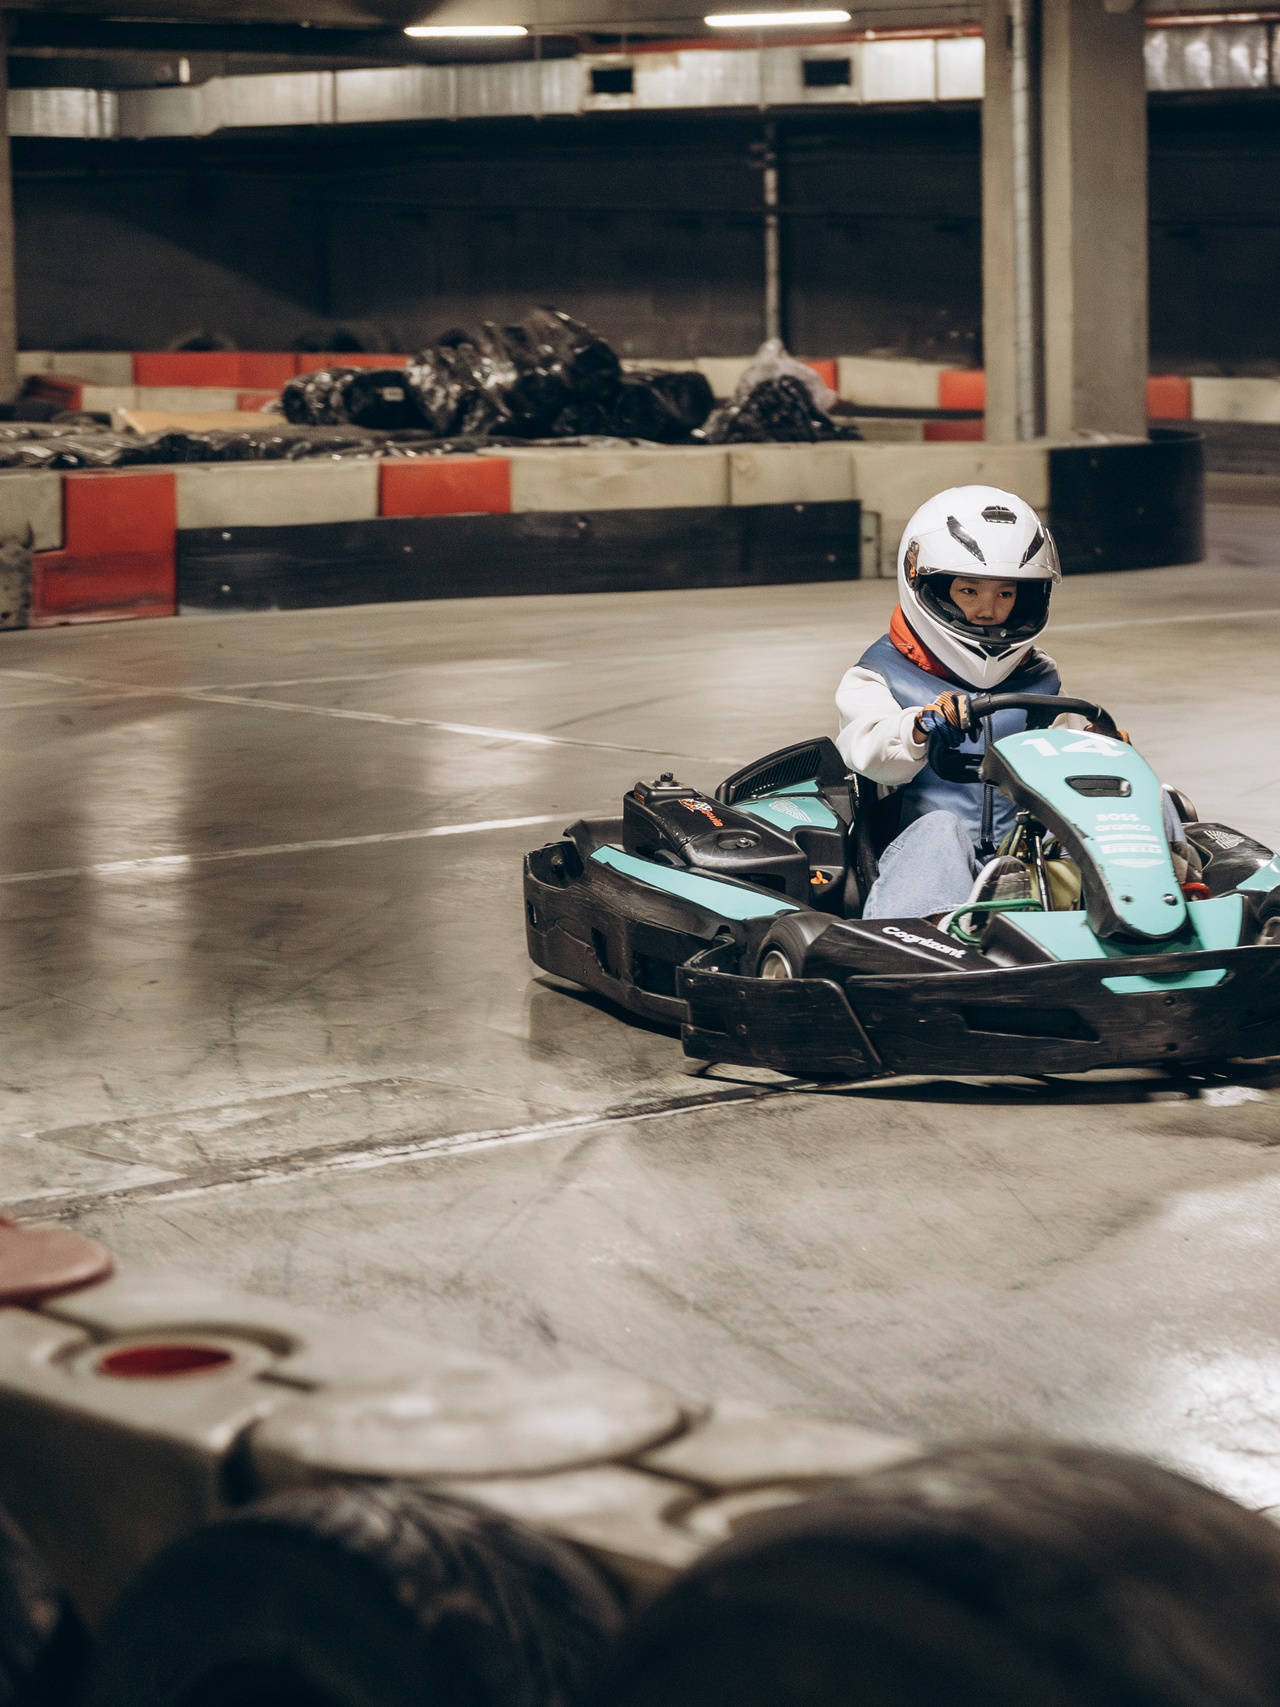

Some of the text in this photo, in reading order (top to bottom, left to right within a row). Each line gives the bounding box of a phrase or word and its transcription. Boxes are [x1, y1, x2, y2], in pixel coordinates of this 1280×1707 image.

[1020, 737, 1127, 757] 14
[1095, 812, 1141, 822] BOSS
[881, 926, 968, 959] Cognizant
